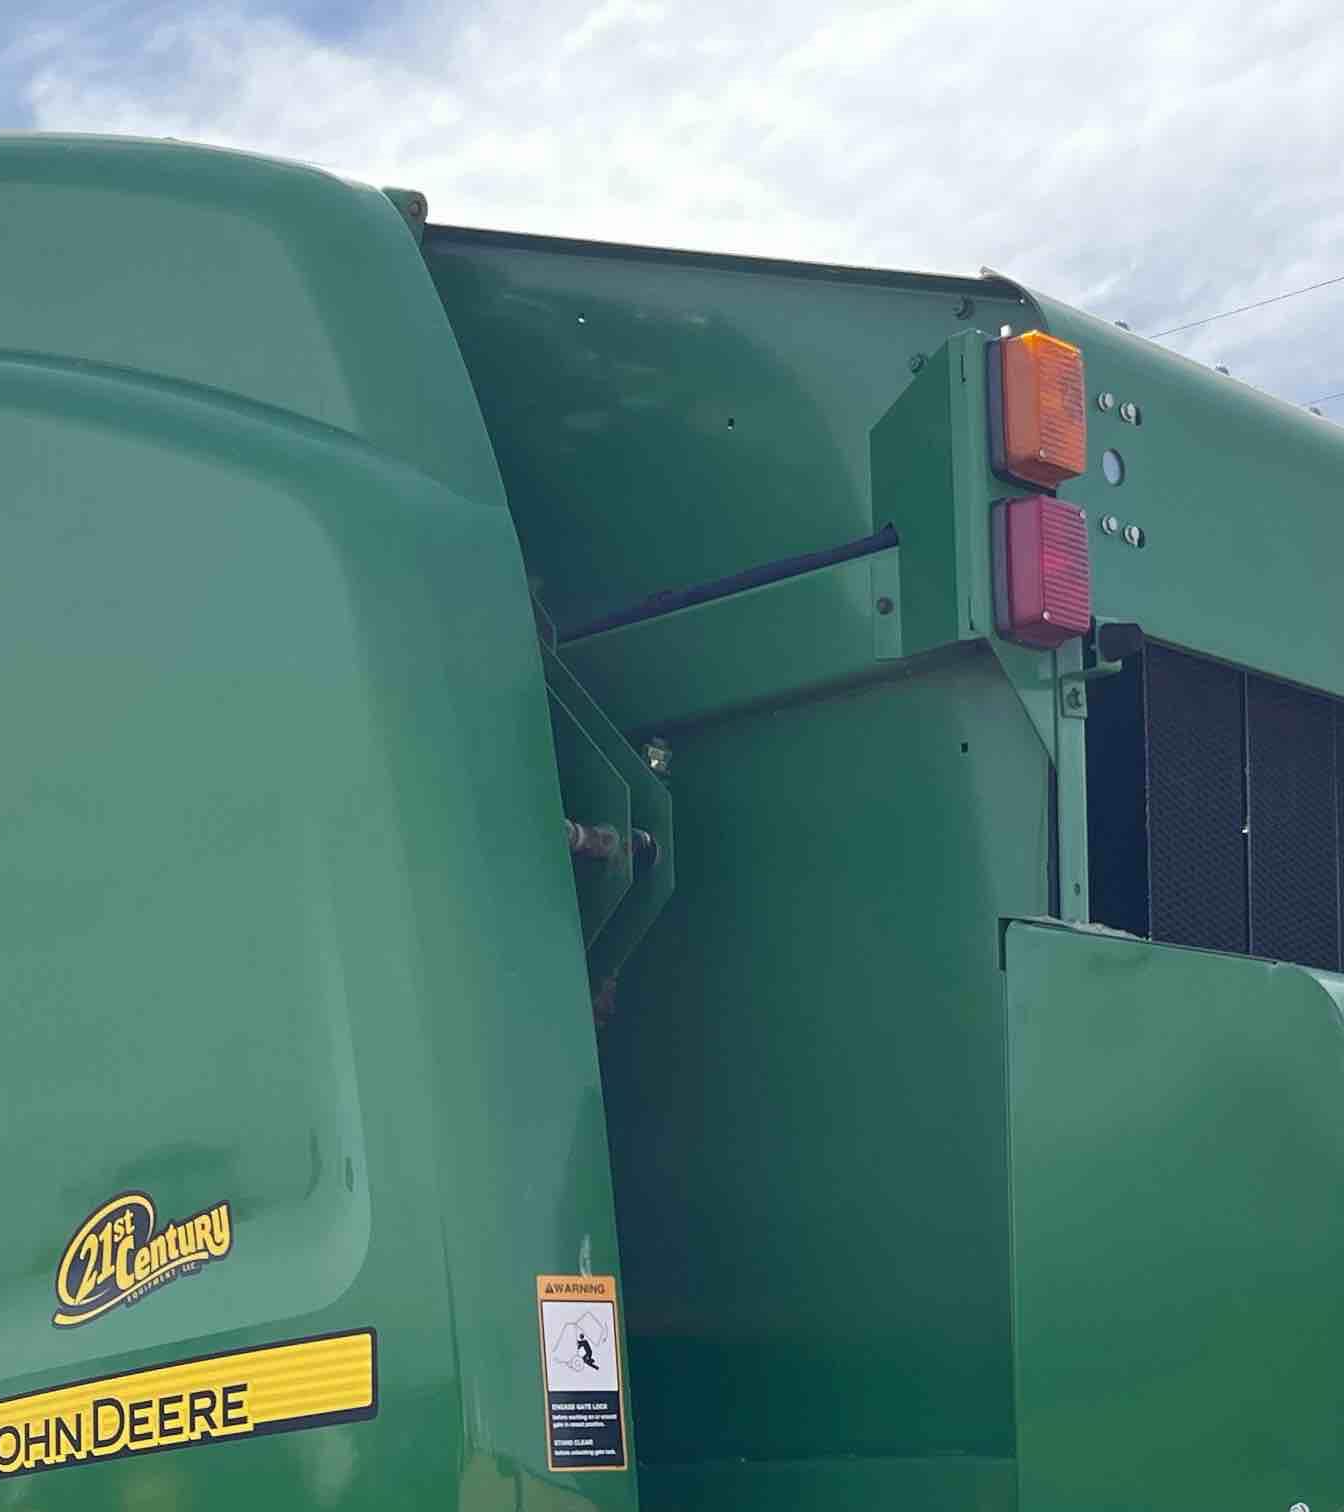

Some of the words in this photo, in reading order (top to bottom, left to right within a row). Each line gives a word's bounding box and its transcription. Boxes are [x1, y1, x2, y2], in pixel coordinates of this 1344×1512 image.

[75, 1209, 136, 1304] 21st
[553, 1283, 606, 1295] WARNING
[92, 1383, 249, 1450] DEERE
